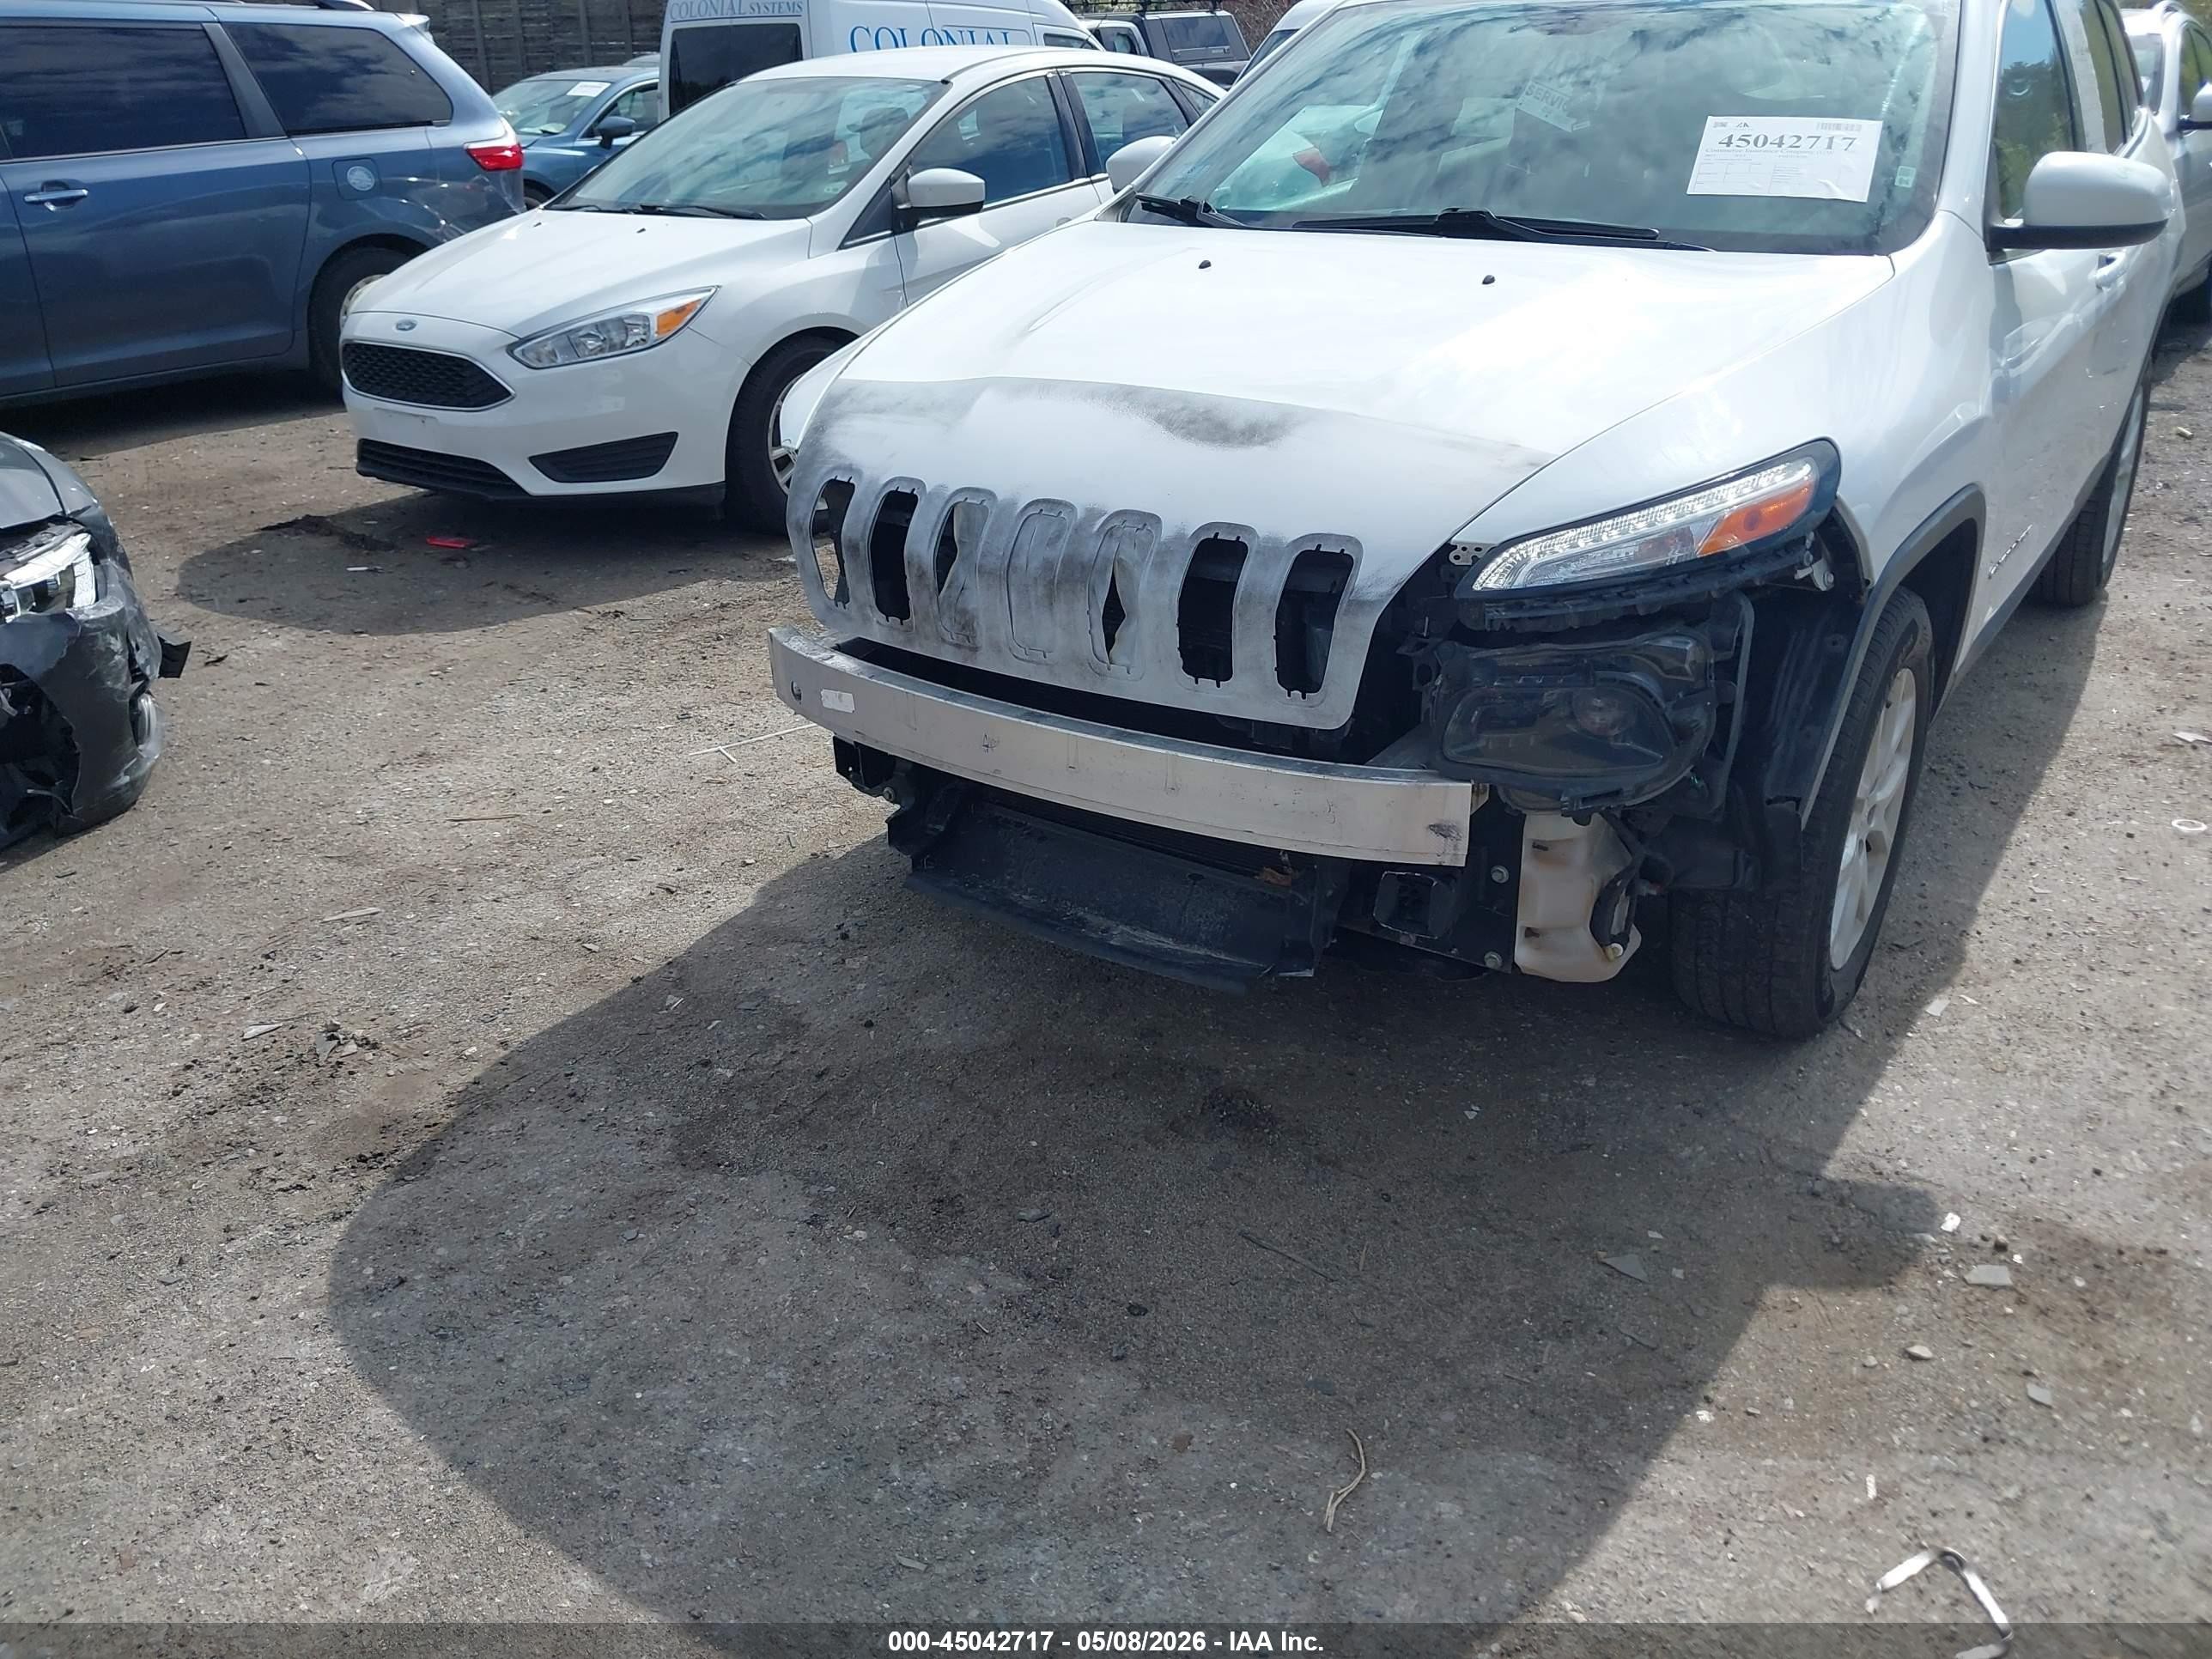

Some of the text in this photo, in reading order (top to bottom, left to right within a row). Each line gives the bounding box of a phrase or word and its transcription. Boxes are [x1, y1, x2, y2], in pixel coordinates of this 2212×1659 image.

[670, 0, 804, 20] COLONIAL SYSTEMS
[1525, 83, 1569, 112] SERVIC
[1718, 134, 1856, 151] 45042717
